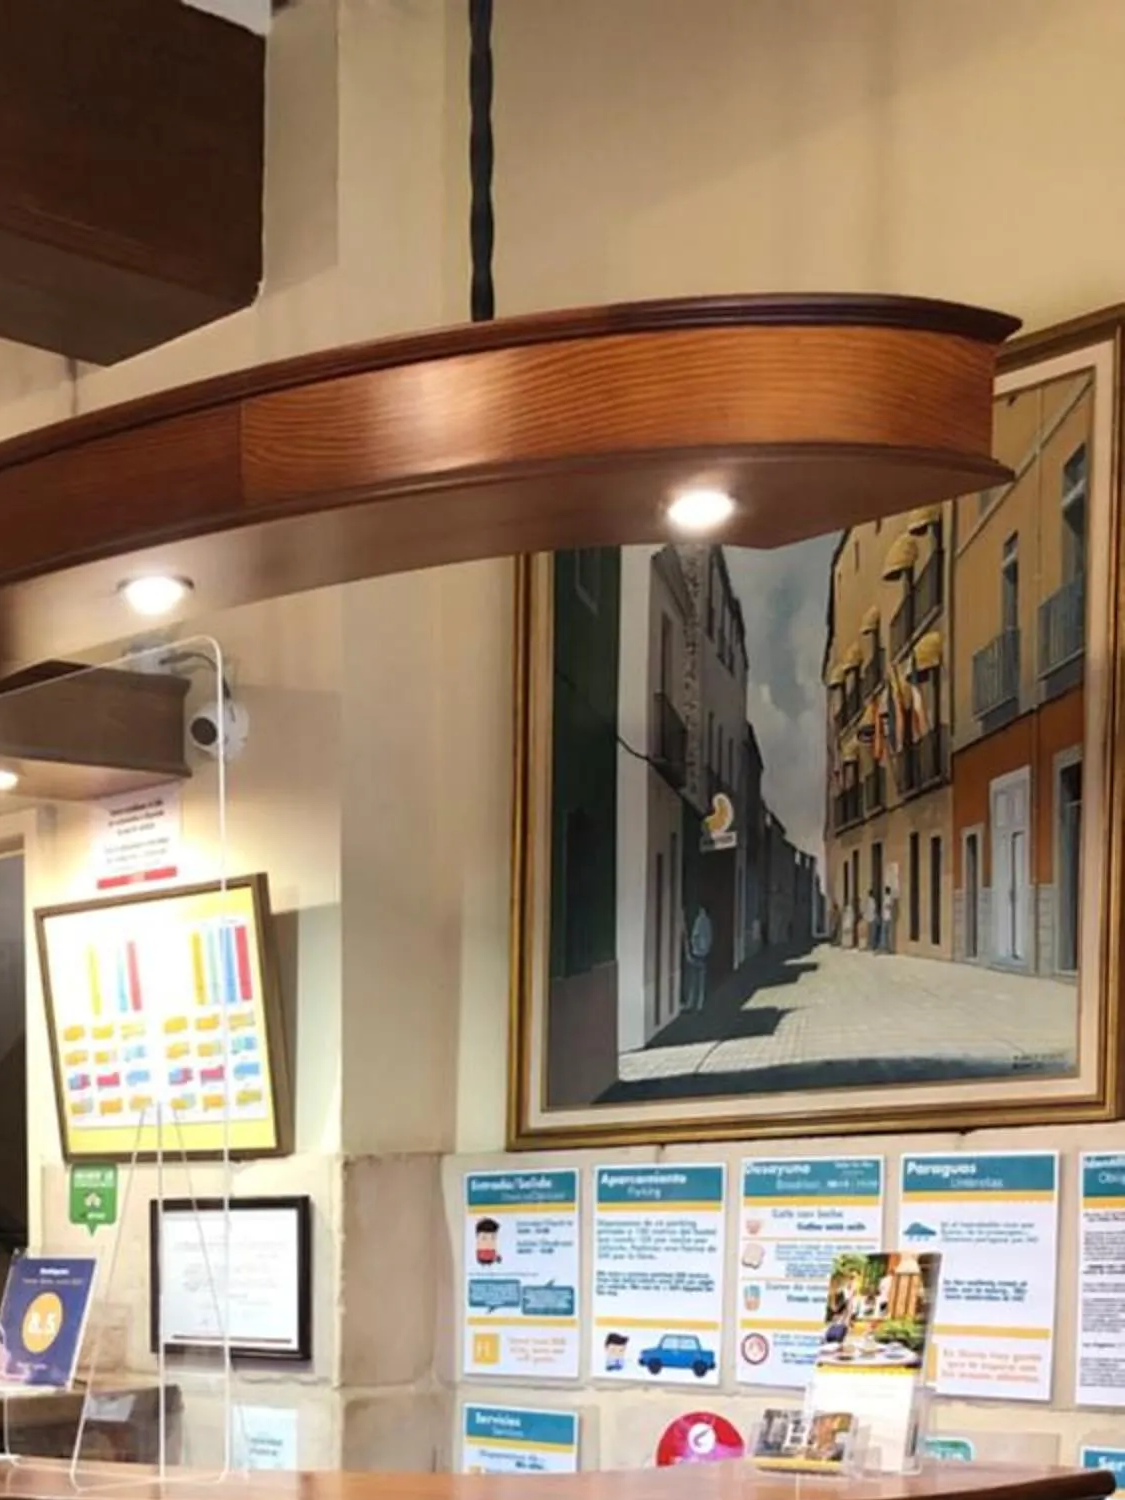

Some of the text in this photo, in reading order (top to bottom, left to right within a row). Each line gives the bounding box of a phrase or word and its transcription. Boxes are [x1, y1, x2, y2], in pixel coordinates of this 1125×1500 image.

[745, 1161, 812, 1177] Desayuno
[906, 1162, 978, 1179] Paraguas
[600, 1170, 687, 1188] Aparcamiento
